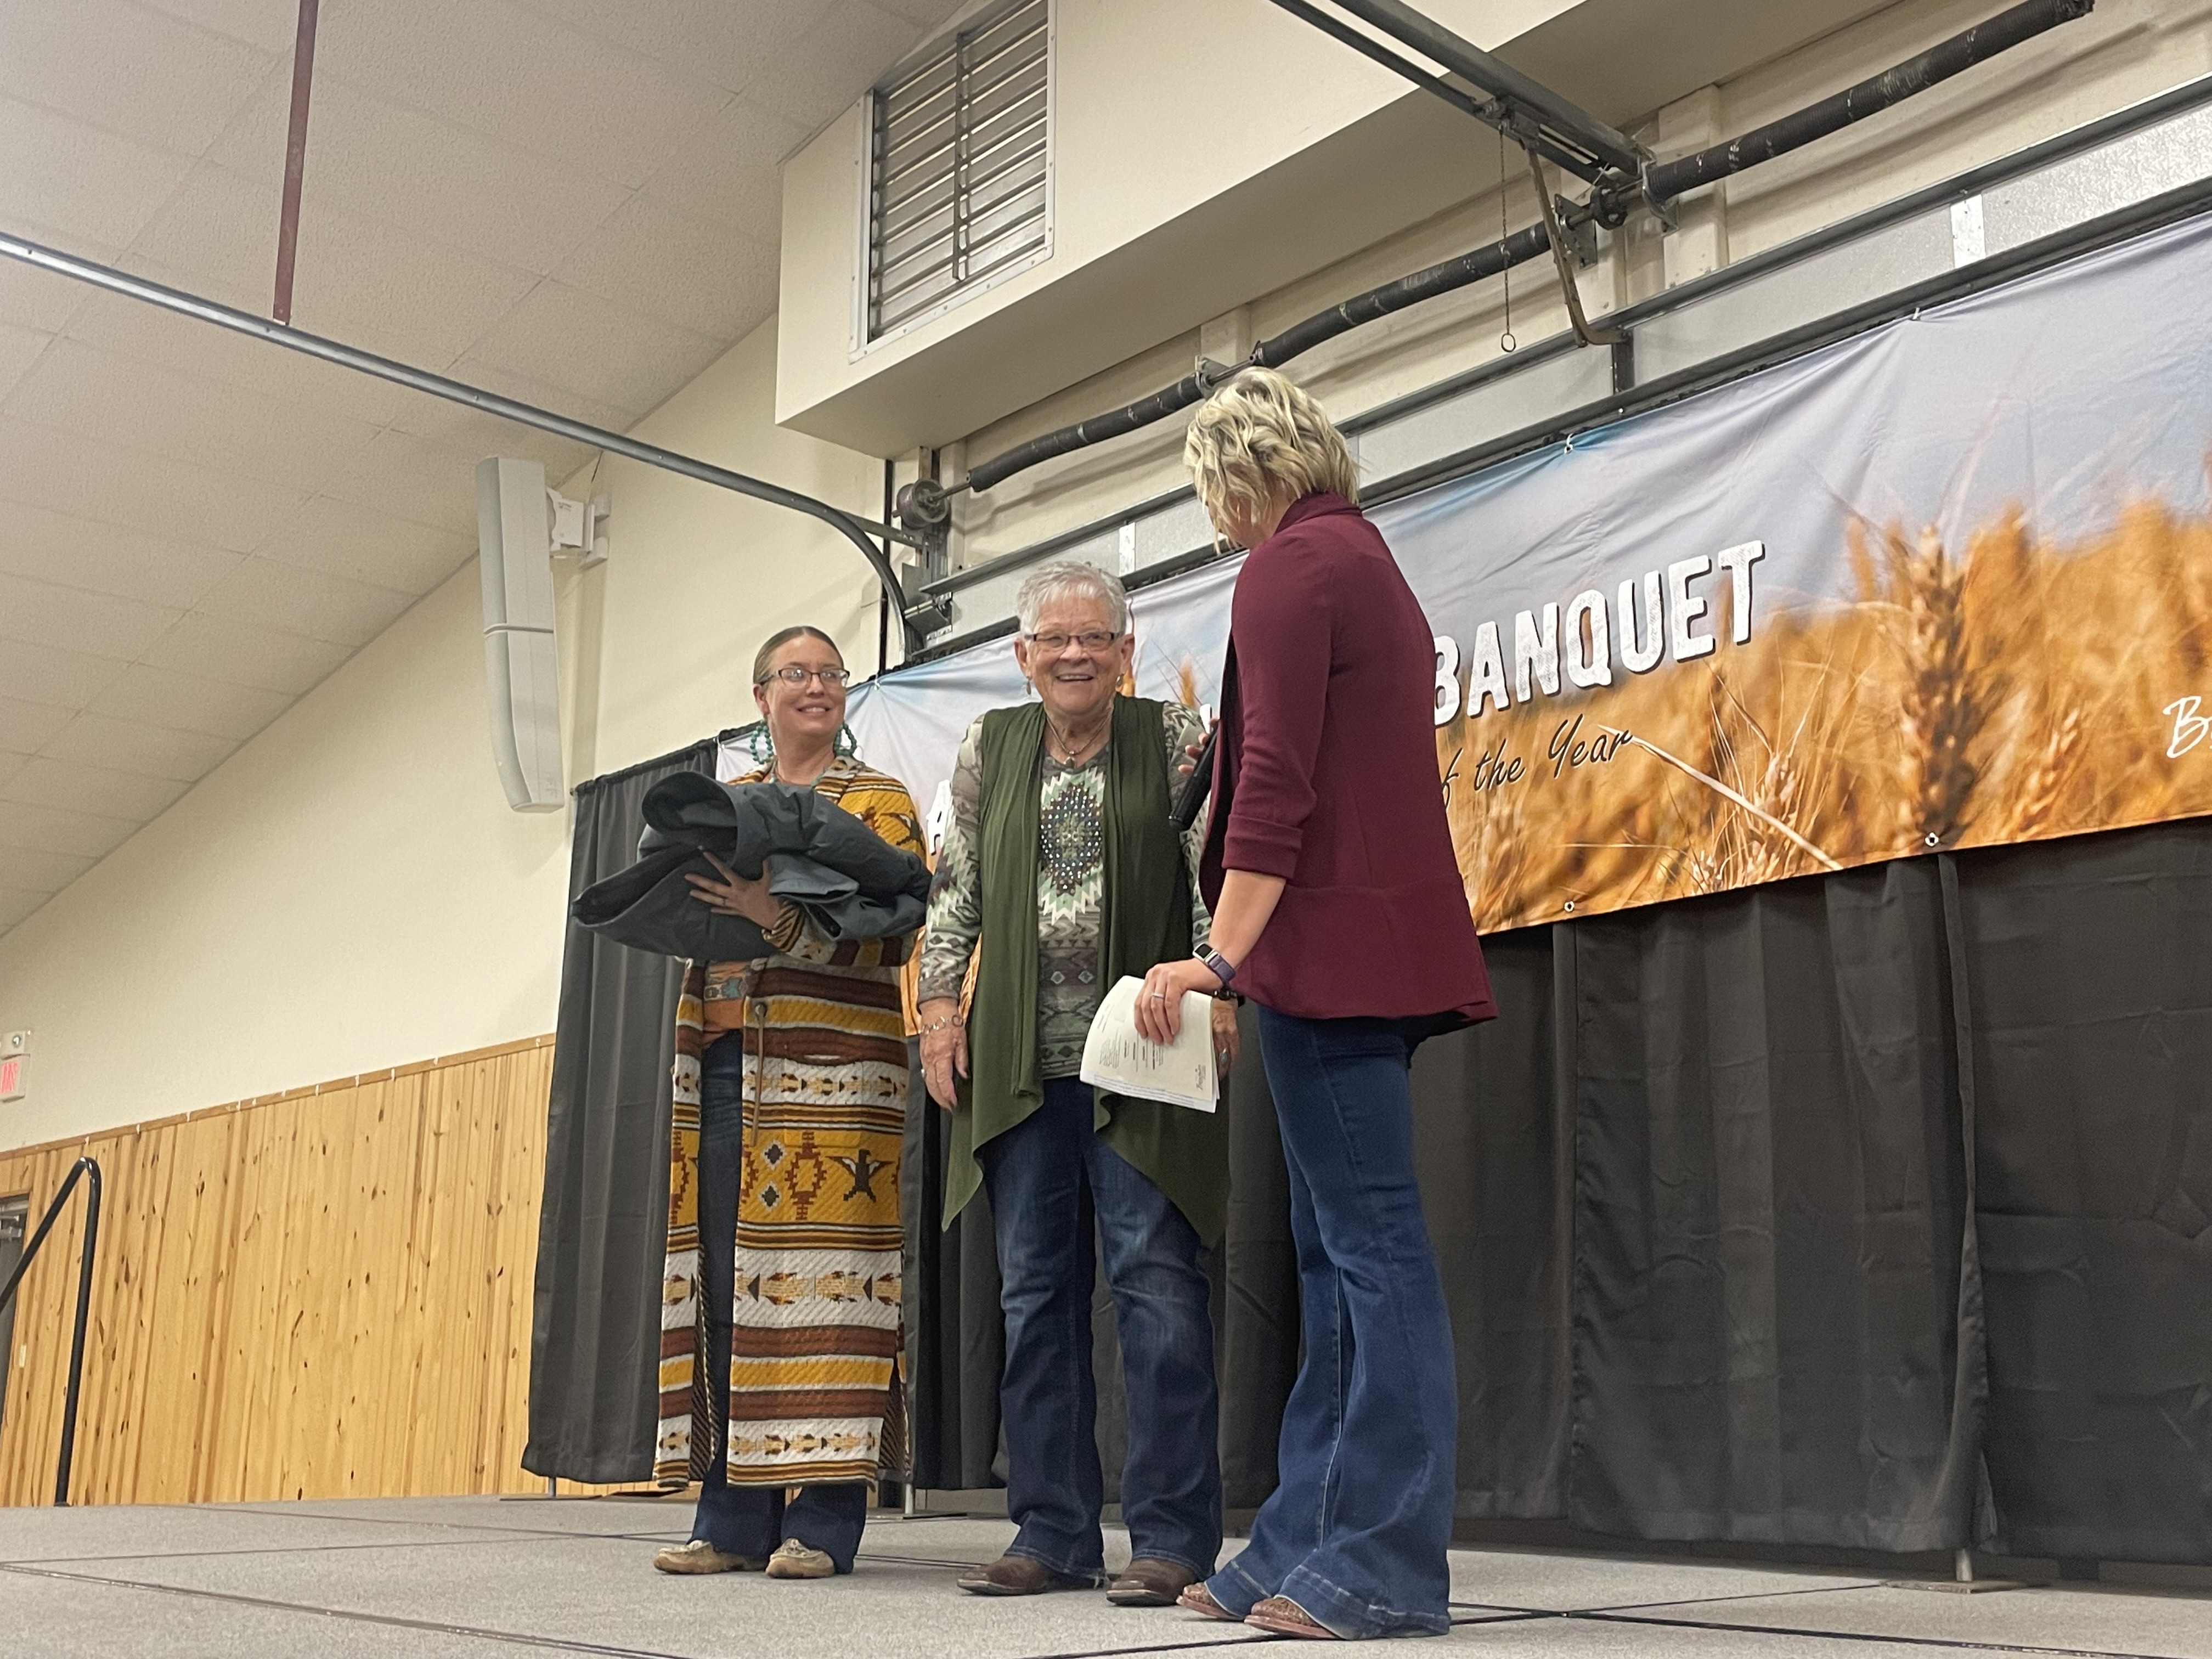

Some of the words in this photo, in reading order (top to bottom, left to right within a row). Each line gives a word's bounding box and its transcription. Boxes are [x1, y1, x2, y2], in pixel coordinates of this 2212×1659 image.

[1434, 540, 1765, 726] BANQUET
[1474, 738, 1526, 791] the
[1548, 713, 1633, 780] Year
